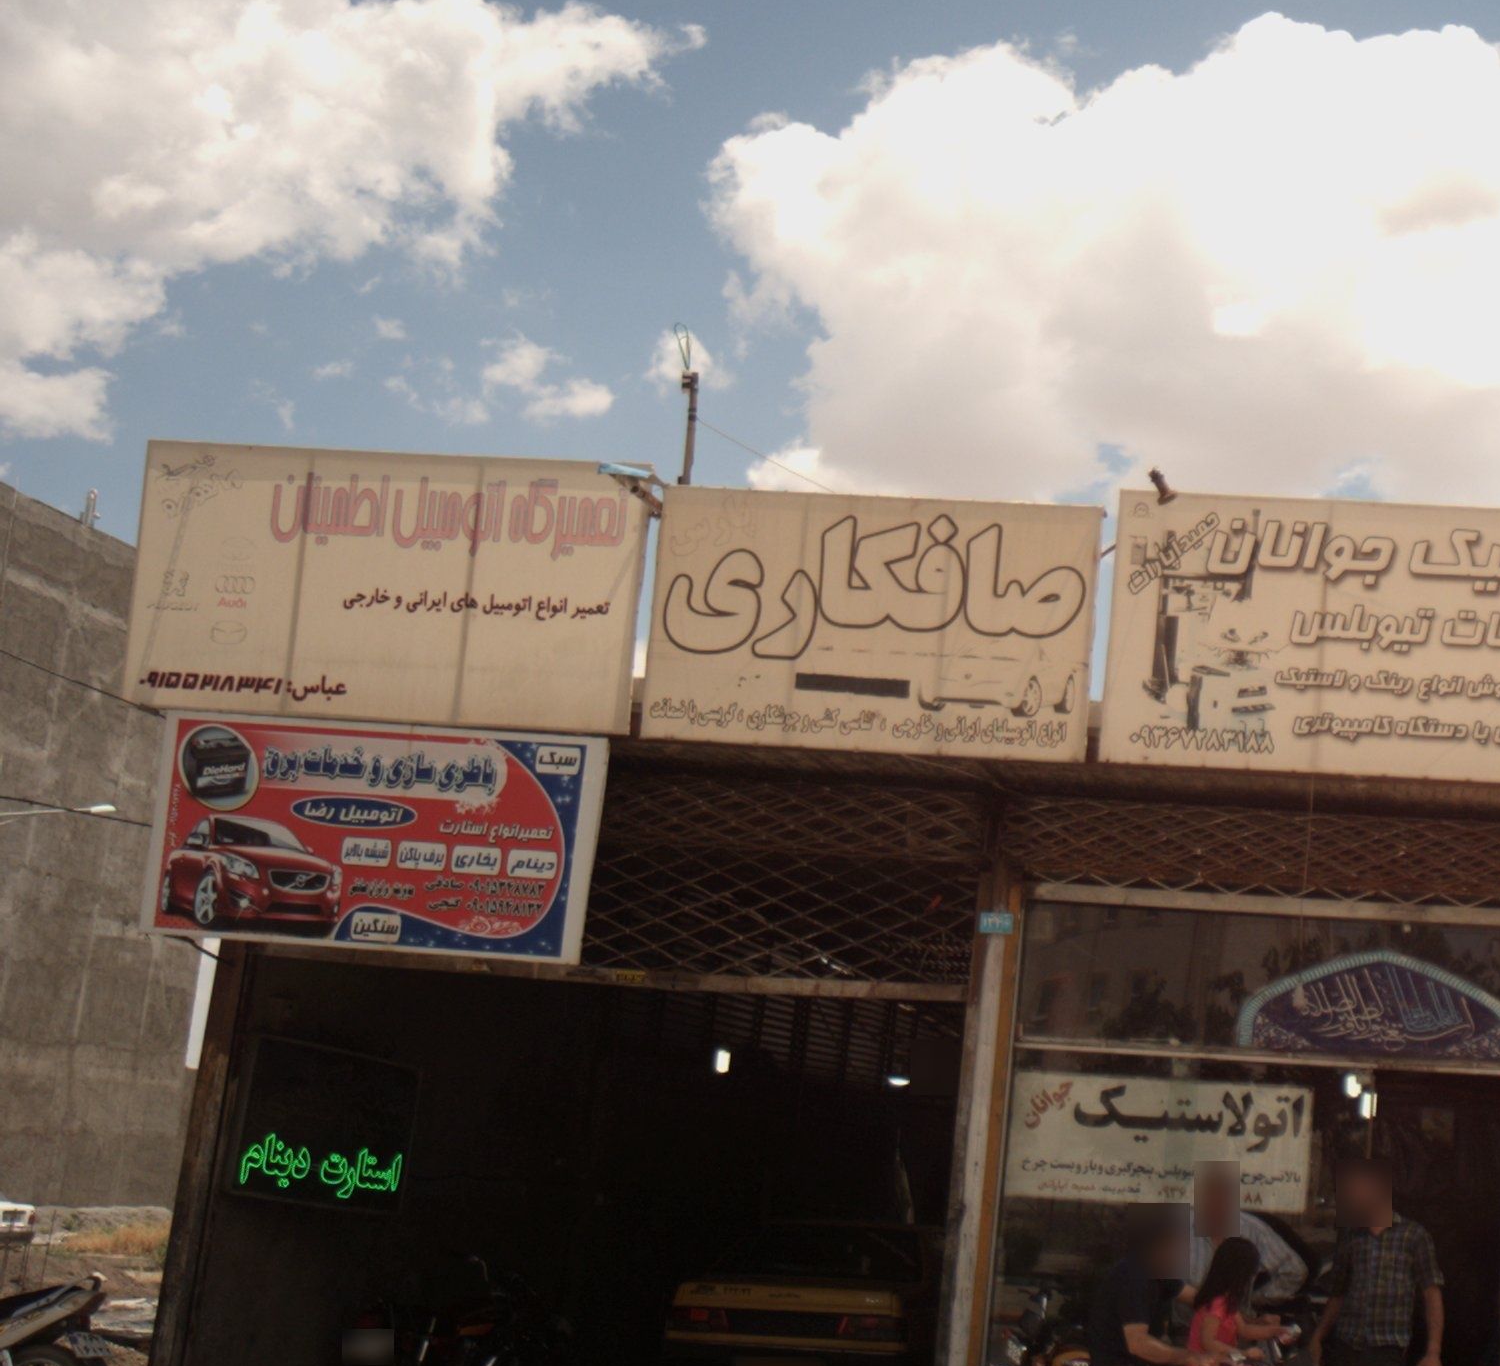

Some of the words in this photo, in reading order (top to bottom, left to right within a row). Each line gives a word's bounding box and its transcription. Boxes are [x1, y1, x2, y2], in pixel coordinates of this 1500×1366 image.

[270, 472, 391, 543] اطمینان
[393, 476, 507, 557] اتومبیل
[509, 478, 629, 560] تعمیرگاه
[1205, 517, 1398, 586] جوانان
[343, 587, 391, 610] خارجی
[662, 513, 1088, 660] صافکاری
[217, 596, 248, 610] Audi
[394, 595, 403, 610] و
[406, 590, 448, 614] ایرانی
[450, 592, 479, 614] های
[482, 594, 533, 615] اتومبیل
[535, 597, 568, 621] انواع
[571, 600, 612, 620] تعمیر
[1289, 603, 1436, 654] تیوبلس
[1274, 668, 1348, 691] لاستیک
[1349, 674, 1360, 691] و
[1363, 669, 1415, 698] رینگ
[1418, 673, 1463, 702] انواع
[1291, 712, 1394, 742] کامپیوتری
[1395, 716, 1469, 739] دستگاه
[1473, 720, 1491, 745] با
[263, 745, 300, 780] برق
[302, 745, 366, 780] خدمات
[366, 755, 384, 788] و
[386, 749, 438, 789] سازی
[538, 750, 578, 769] سبک
[438, 753, 498, 795] باطری
[304, 800, 335, 822] رضا
[340, 802, 403, 825] اتومبیل
[438, 819, 488, 836] استارت
[453, 851, 498, 871] بخاری
[509, 857, 556, 874] دینام
[353, 917, 400, 937] سنگین
[1024, 1080, 1074, 1130] جوانان
[239, 1131, 312, 1189] دینام
[319, 1147, 403, 1200] استارت
